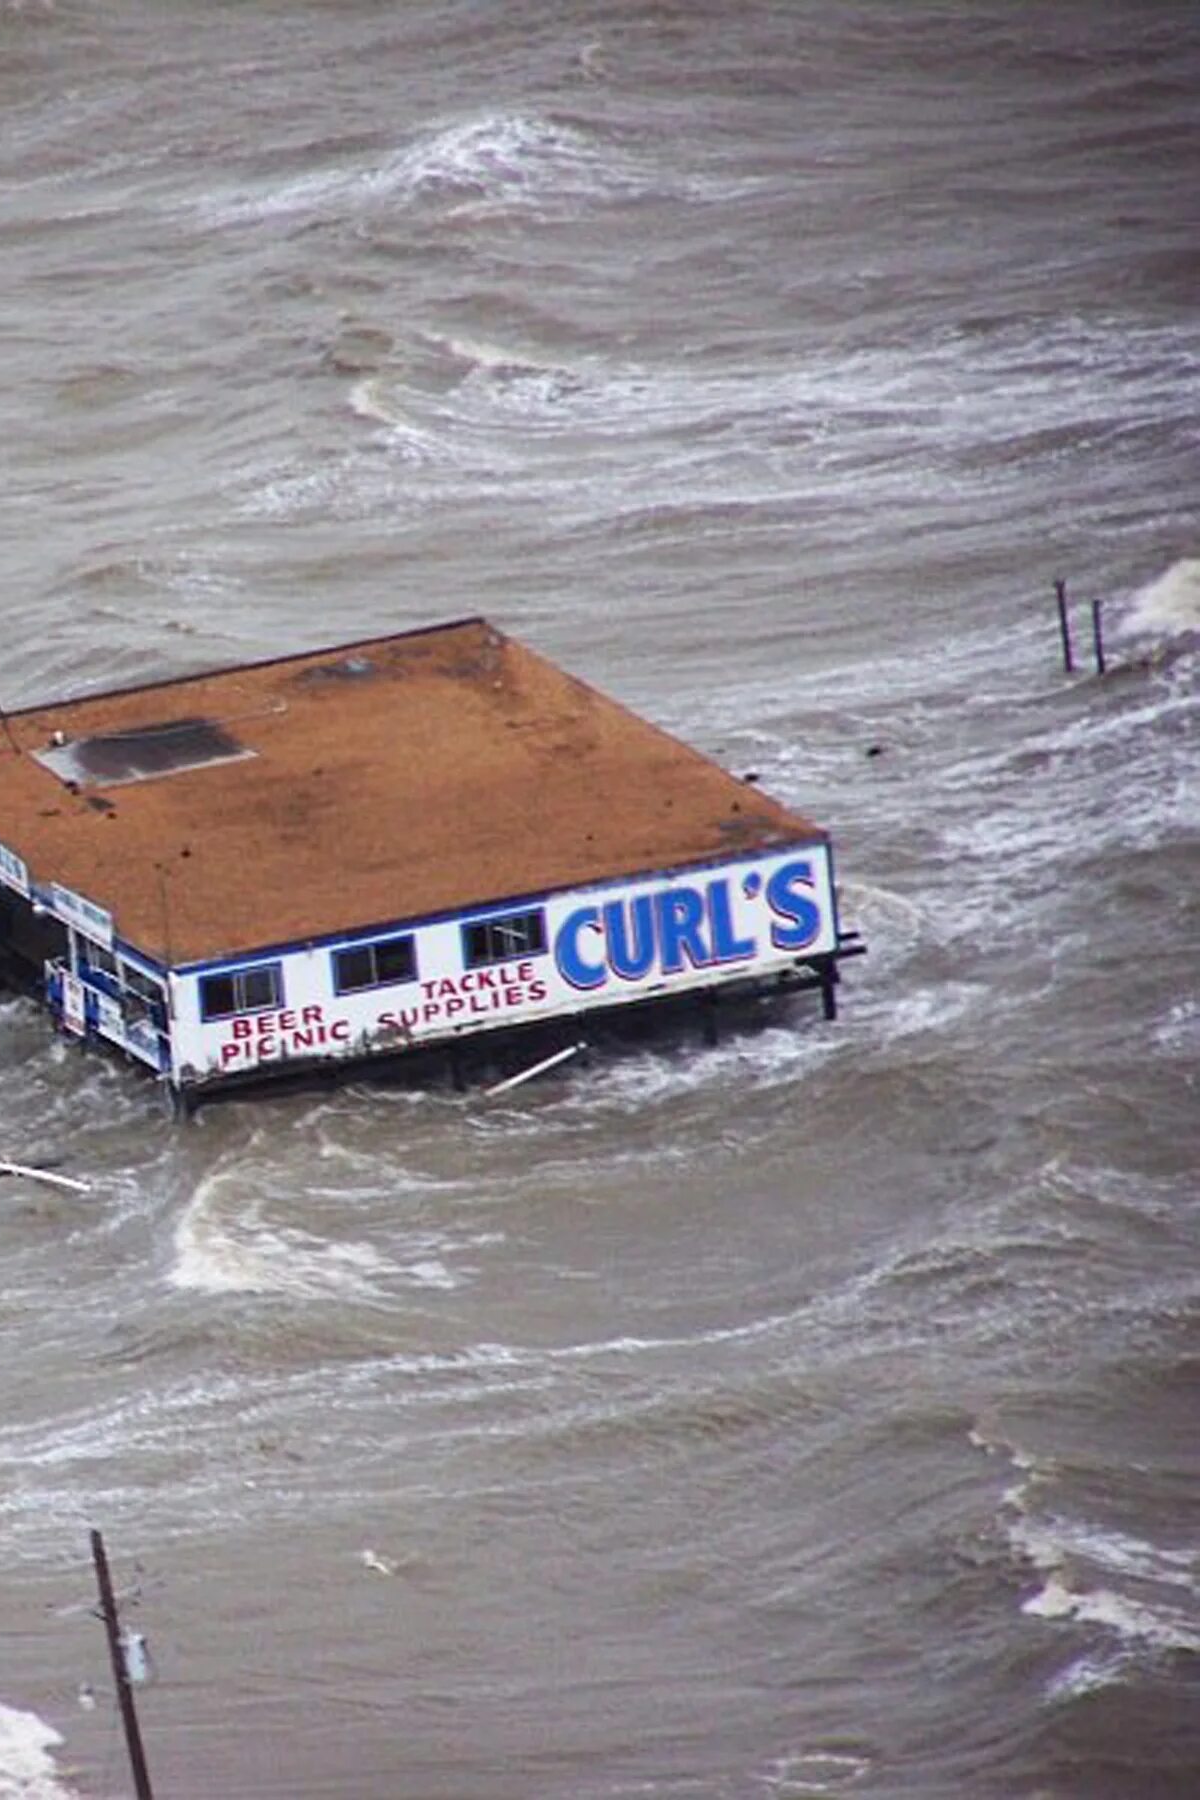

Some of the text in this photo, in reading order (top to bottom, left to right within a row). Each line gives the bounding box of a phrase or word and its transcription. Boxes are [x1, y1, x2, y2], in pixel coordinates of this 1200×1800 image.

[554, 861, 821, 990] CURL'S
[421, 961, 535, 999] TACKLE
[221, 980, 547, 1067] PICNIC SUPPLIES
[232, 1004, 323, 1040] BEER
